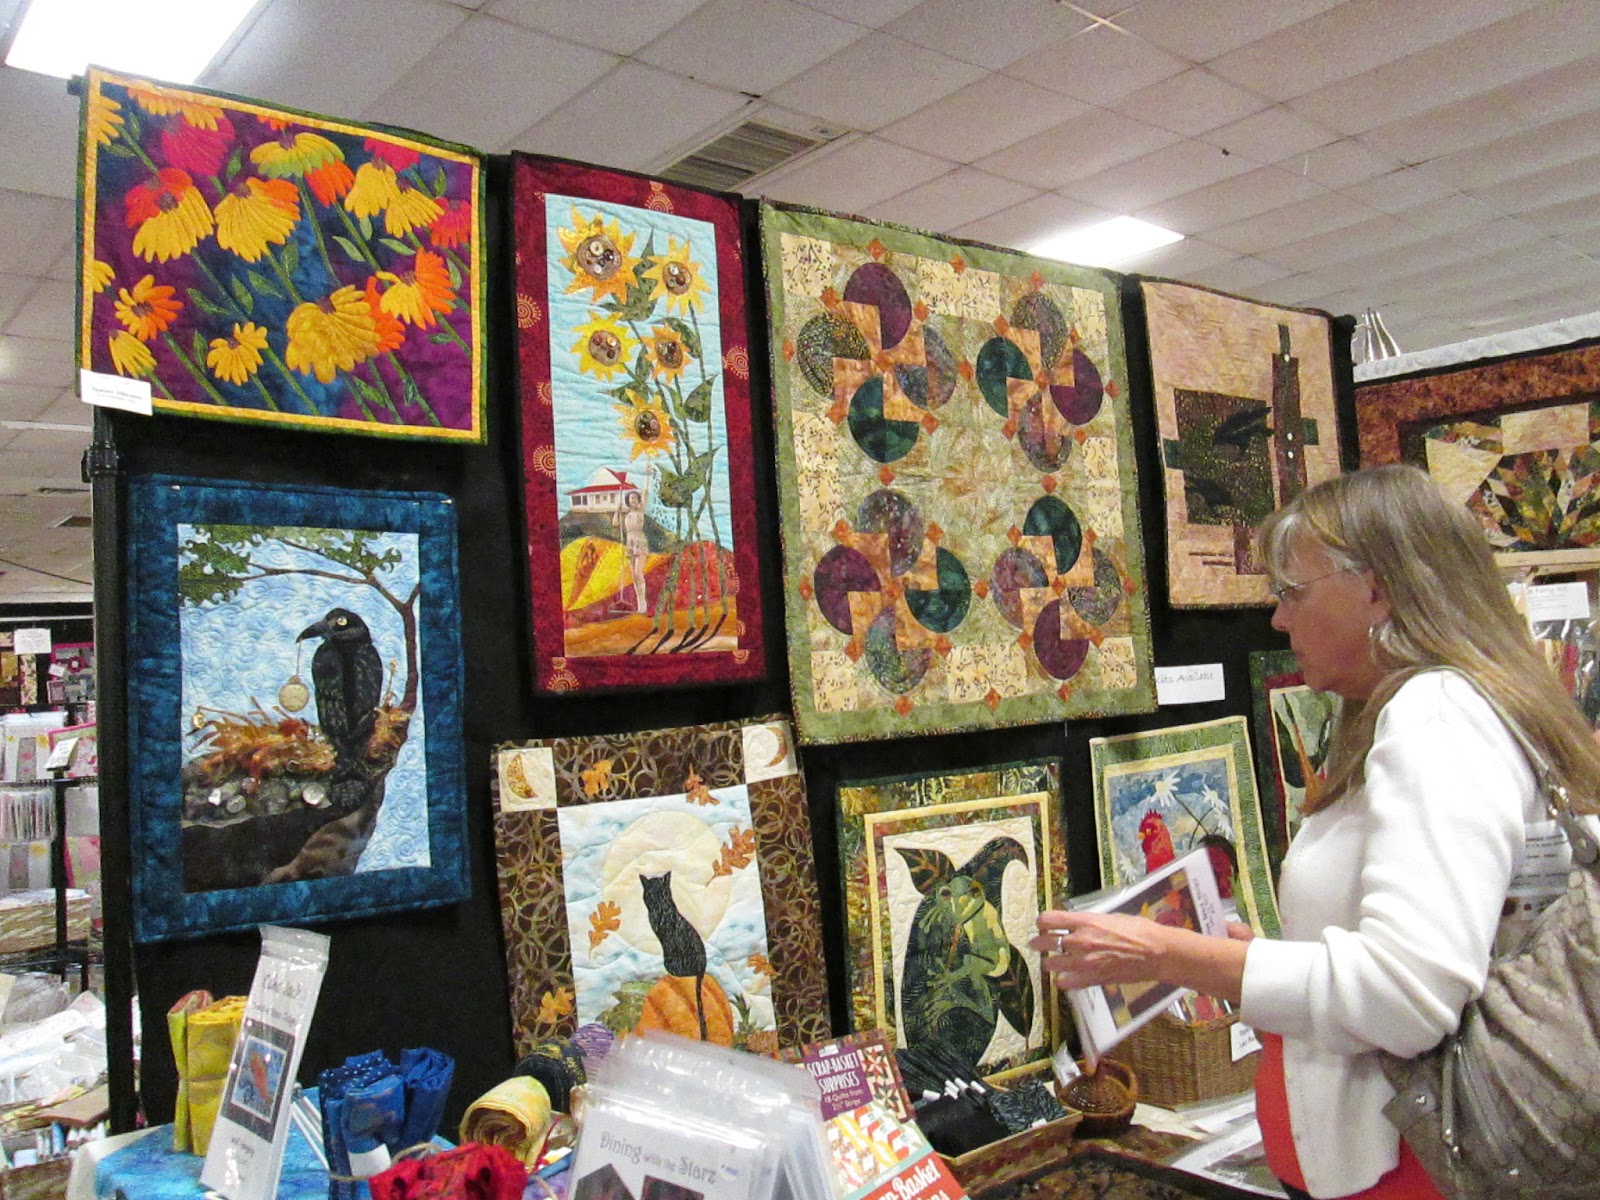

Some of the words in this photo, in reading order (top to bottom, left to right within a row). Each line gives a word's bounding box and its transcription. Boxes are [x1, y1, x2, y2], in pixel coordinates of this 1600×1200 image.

[806, 1052, 860, 1077] SCRAP-BASKET
[818, 1070, 861, 1094] SURPRISES
[600, 1132, 642, 1165] Dining
[678, 1155, 718, 1185] Starz
